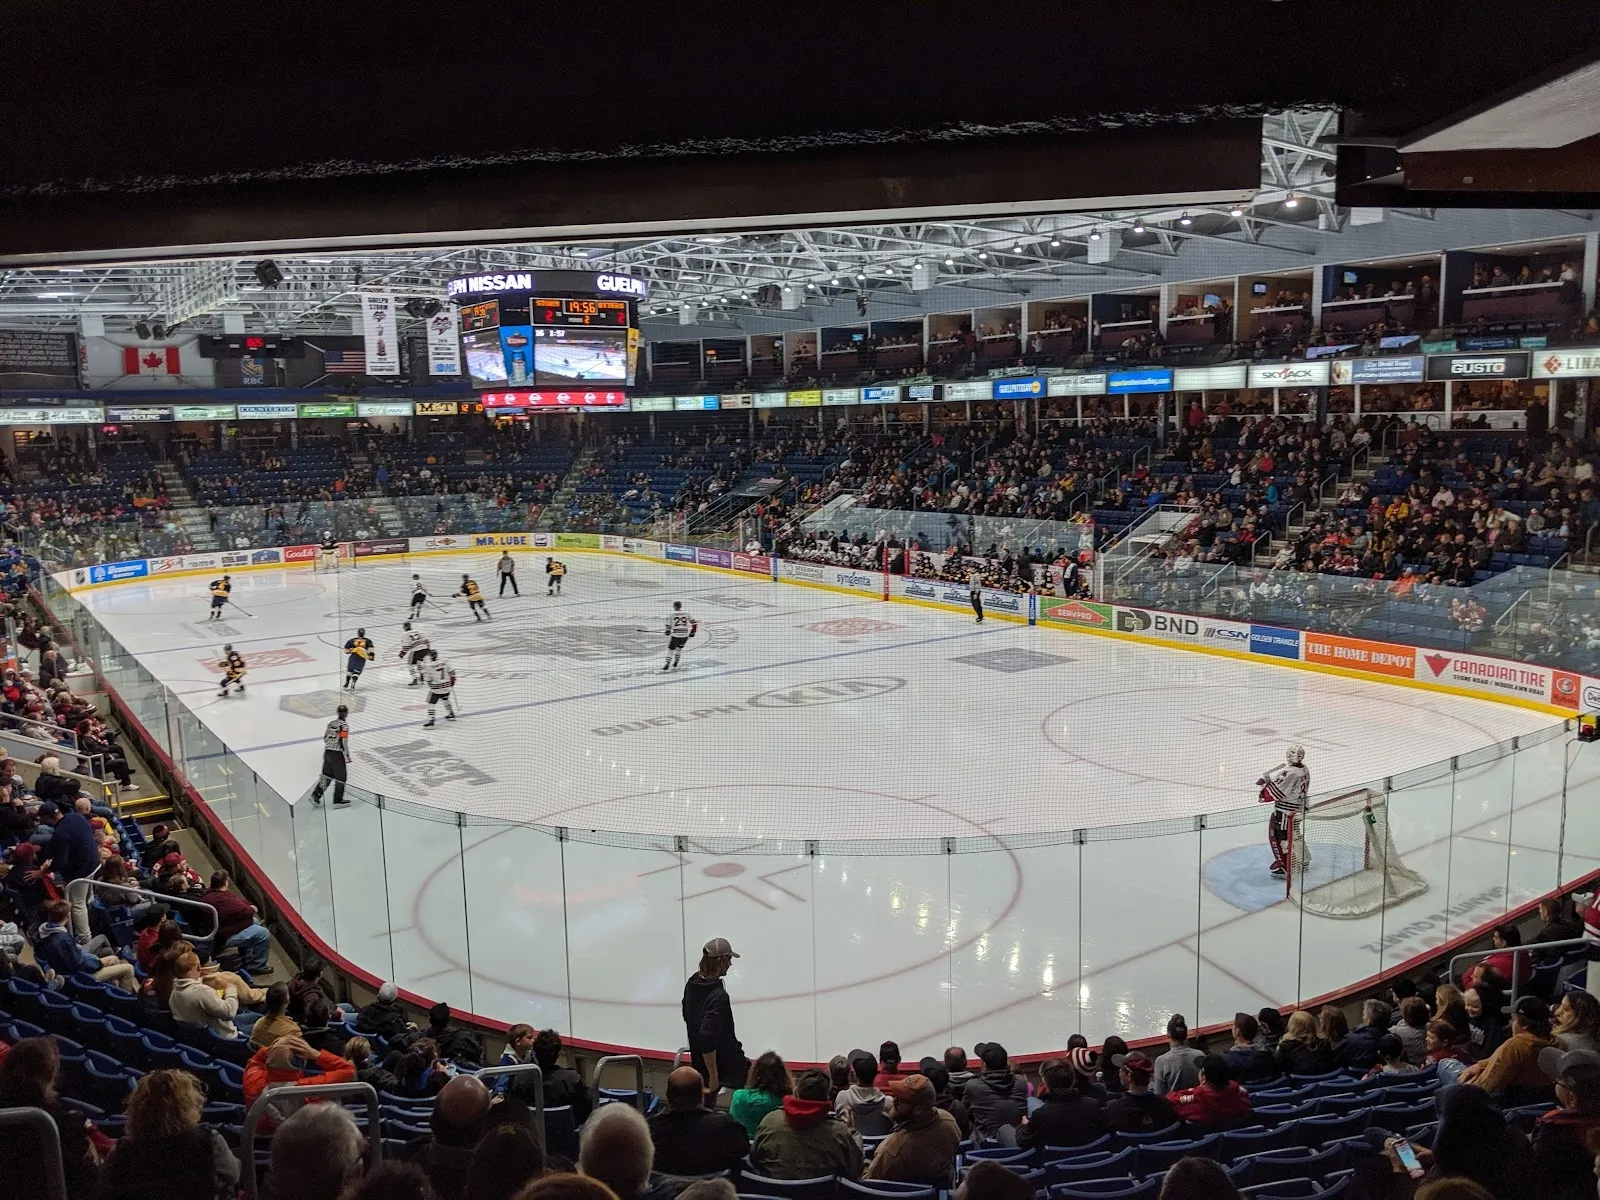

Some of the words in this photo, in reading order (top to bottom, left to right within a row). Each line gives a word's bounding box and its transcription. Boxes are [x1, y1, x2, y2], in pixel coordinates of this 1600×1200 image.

[468, 274, 532, 292] NISSAN
[569, 302, 596, 313] 19:56
[1451, 363, 1505, 374] GUSTO
[243, 377, 264, 385] RBC
[476, 537, 499, 546] MR.
[500, 536, 527, 545] LUBE
[837, 572, 871, 586] syngenta
[1058, 609, 1091, 619] SERVPRO
[673, 617, 687, 627] 29
[1155, 615, 1199, 635] BND
[1216, 629, 1249, 639] CSN
[1251, 634, 1273, 643] GOLDEN
[1273, 637, 1299, 647] TRIANGLE
[1307, 642, 1331, 656] THE
[1334, 646, 1368, 662] HOME
[1371, 651, 1413, 669] DEPOT
[1453, 660, 1516, 682] CANADIAN
[1519, 670, 1545, 687] TIRE
[1453, 674, 1471, 682] STONE
[1472, 677, 1489, 685] ROAD
[1494, 681, 1528, 692] WOODLAWN
[1529, 688, 1545, 696] ROAD
[592, 704, 748, 737] GUELPH
